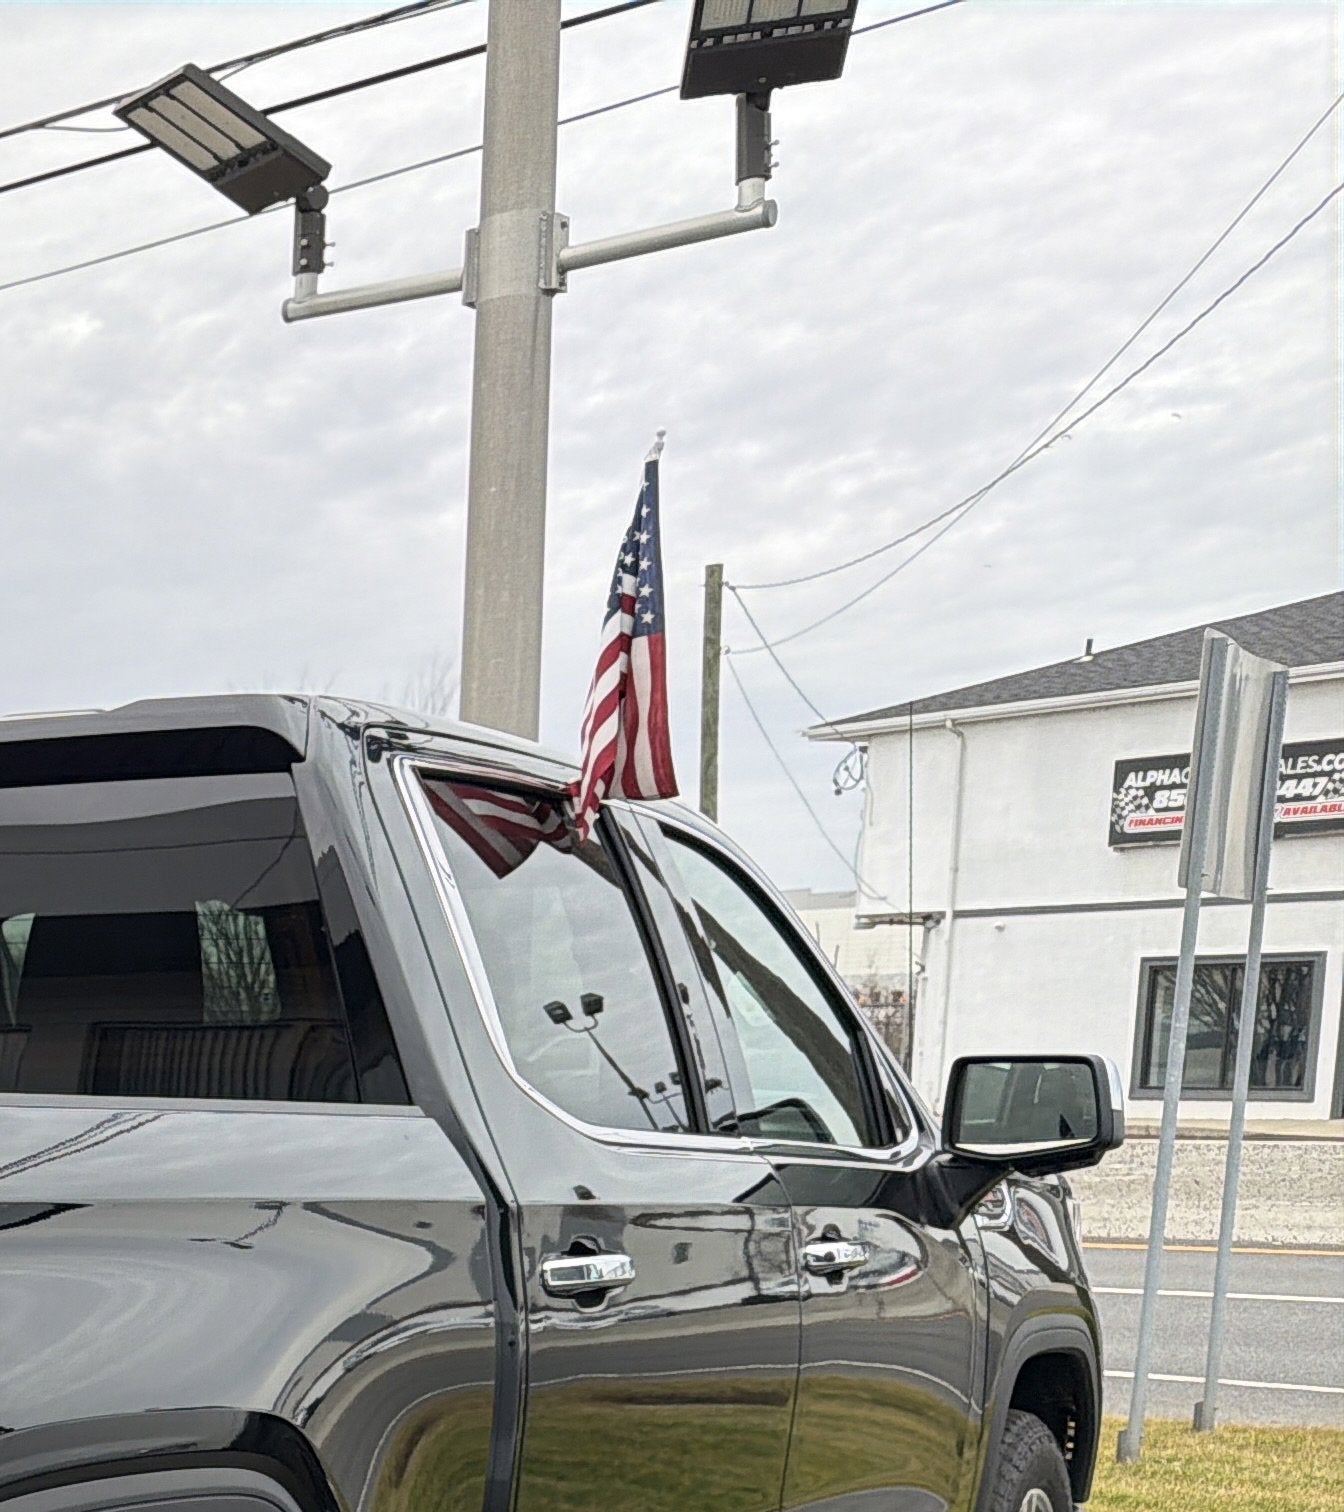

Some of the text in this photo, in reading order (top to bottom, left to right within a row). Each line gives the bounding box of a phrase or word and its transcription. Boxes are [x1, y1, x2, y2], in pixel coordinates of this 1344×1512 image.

[1123, 752, 1344, 788] ALPHAC ALES.CO
[1153, 776, 1329, 808] 85 447
[1128, 815, 1184, 829] FINANCIN
[1283, 803, 1344, 817] AVAILABL
